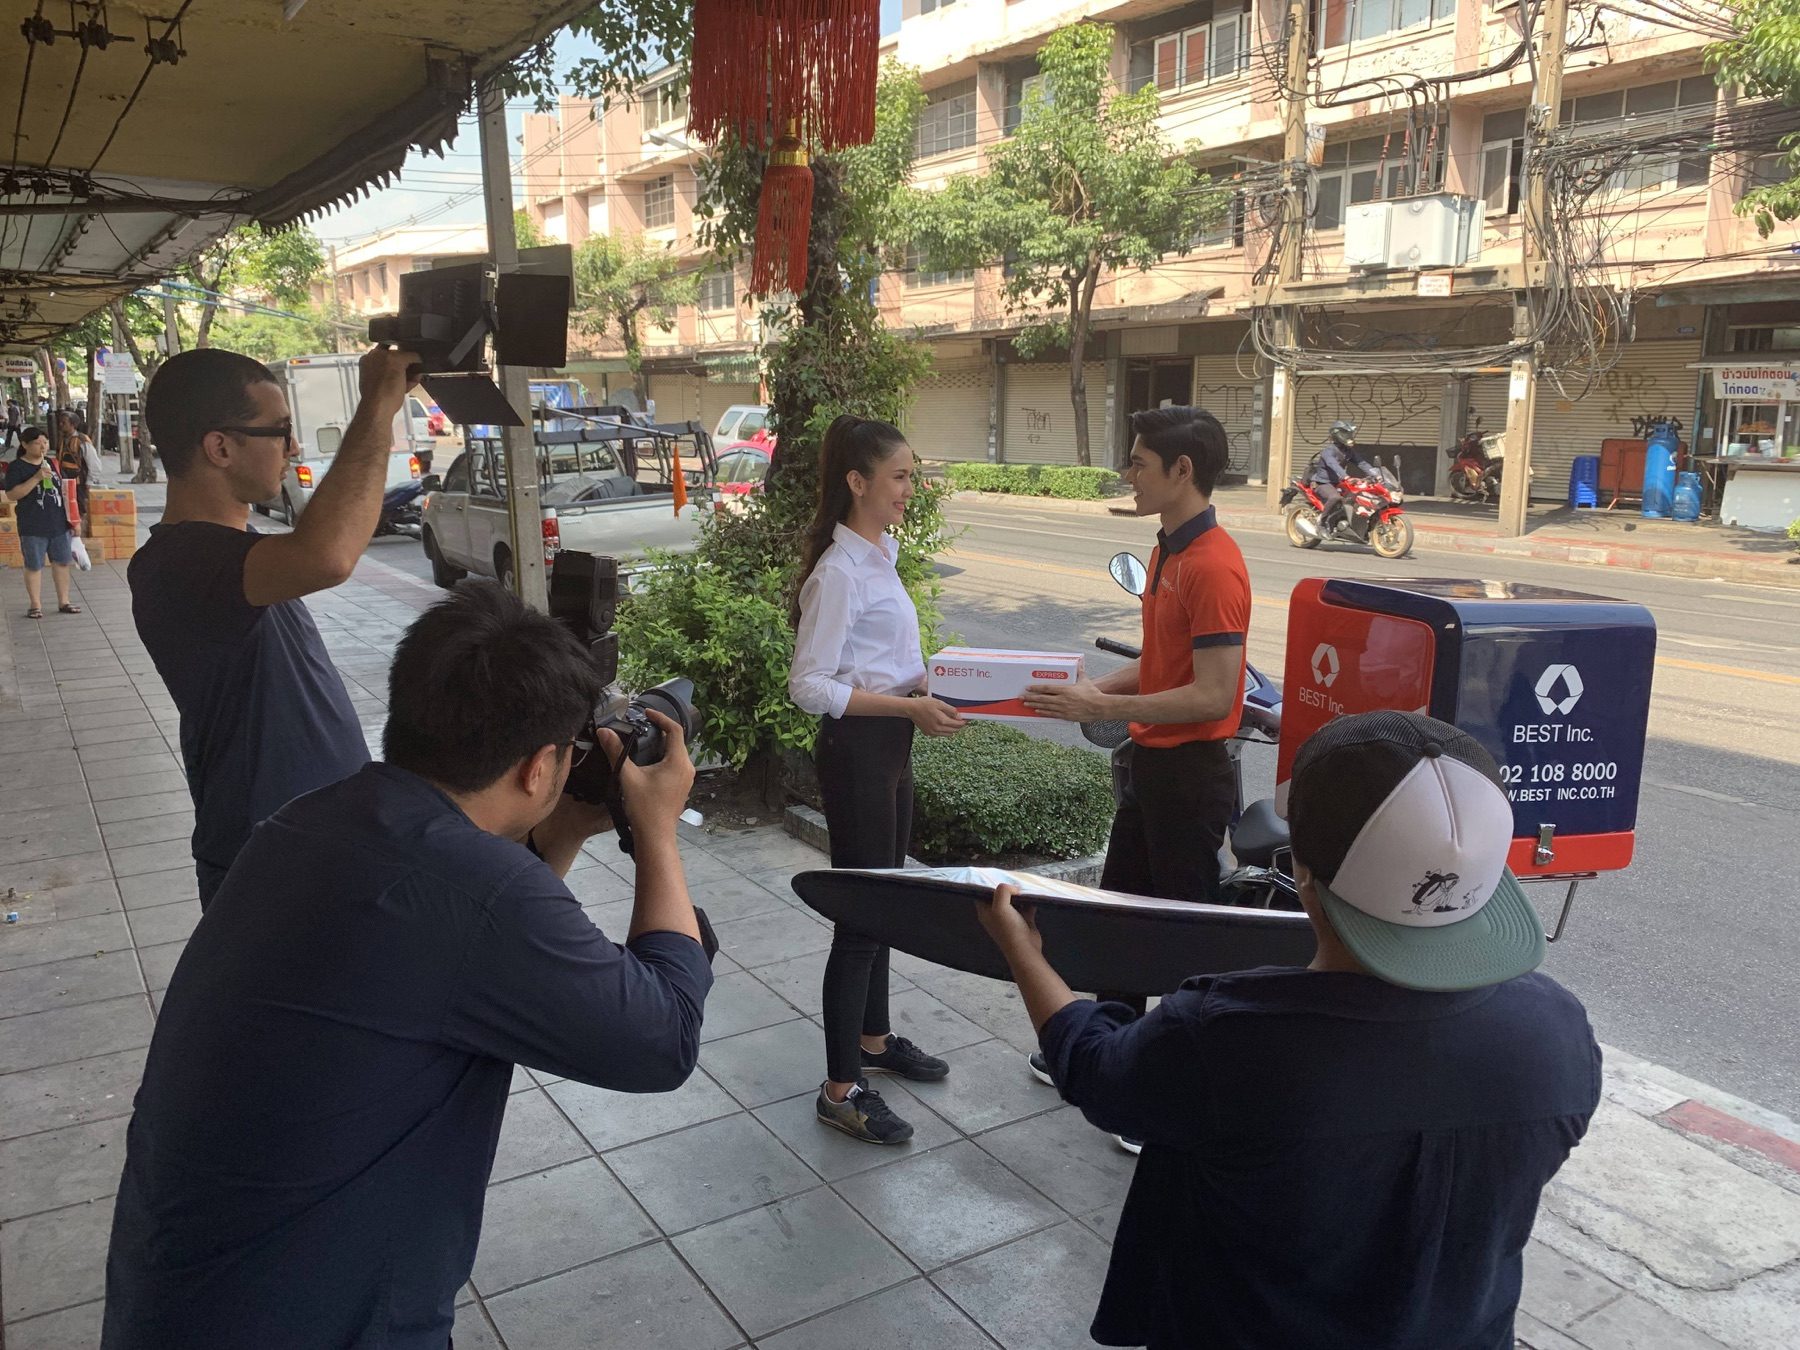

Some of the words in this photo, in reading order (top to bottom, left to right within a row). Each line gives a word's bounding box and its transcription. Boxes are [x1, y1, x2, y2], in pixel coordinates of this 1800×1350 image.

[1723, 382, 1759, 395] ไก่ทอด
[947, 667, 974, 677] BEST
[976, 668, 992, 679] Inc.
[1036, 671, 1065, 679] EXPRESS
[1299, 686, 1327, 709] BEST
[1513, 724, 1563, 742] BEST
[1566, 724, 1594, 742] Inc.
[1499, 765, 1523, 783] 02
[1530, 764, 1565, 782] 108
[1571, 762, 1617, 781] 8000
[1557, 786, 1615, 800] INC.CO.TH
